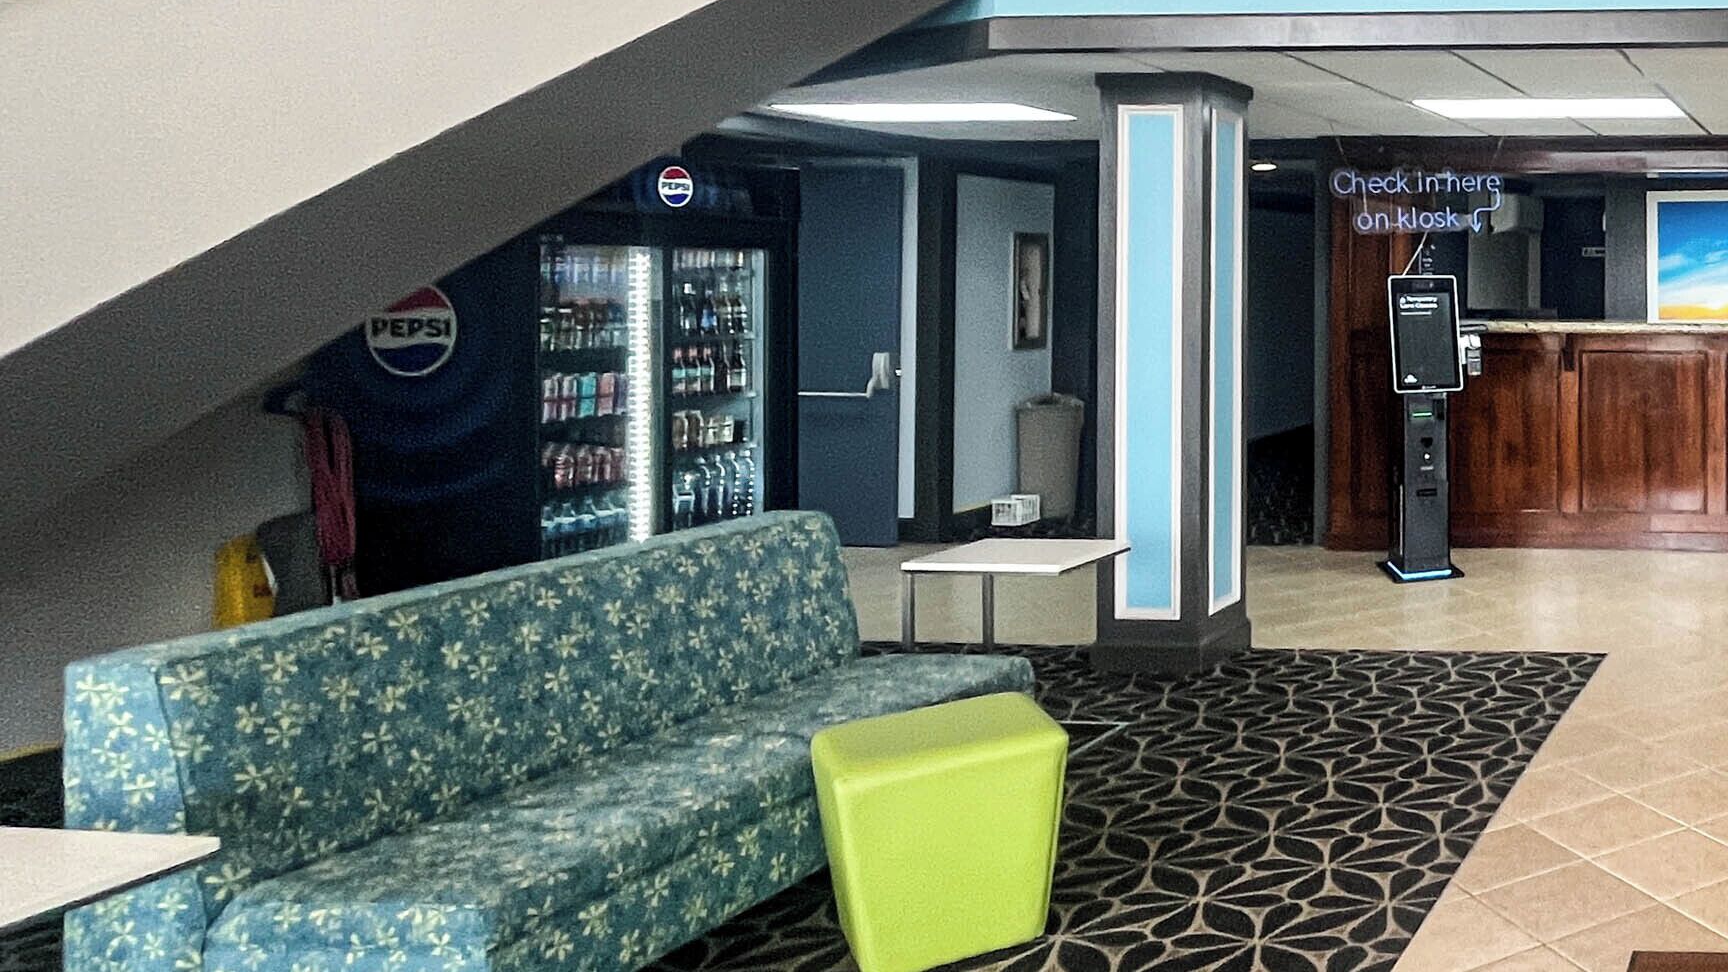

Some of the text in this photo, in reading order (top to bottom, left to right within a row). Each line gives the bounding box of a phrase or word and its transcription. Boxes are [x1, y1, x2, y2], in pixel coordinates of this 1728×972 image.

[661, 181, 691, 192] PEPSI
[1333, 170, 1501, 194] Check in here
[1357, 206, 1460, 230] on kiosk
[371, 317, 451, 339] PEPSI
